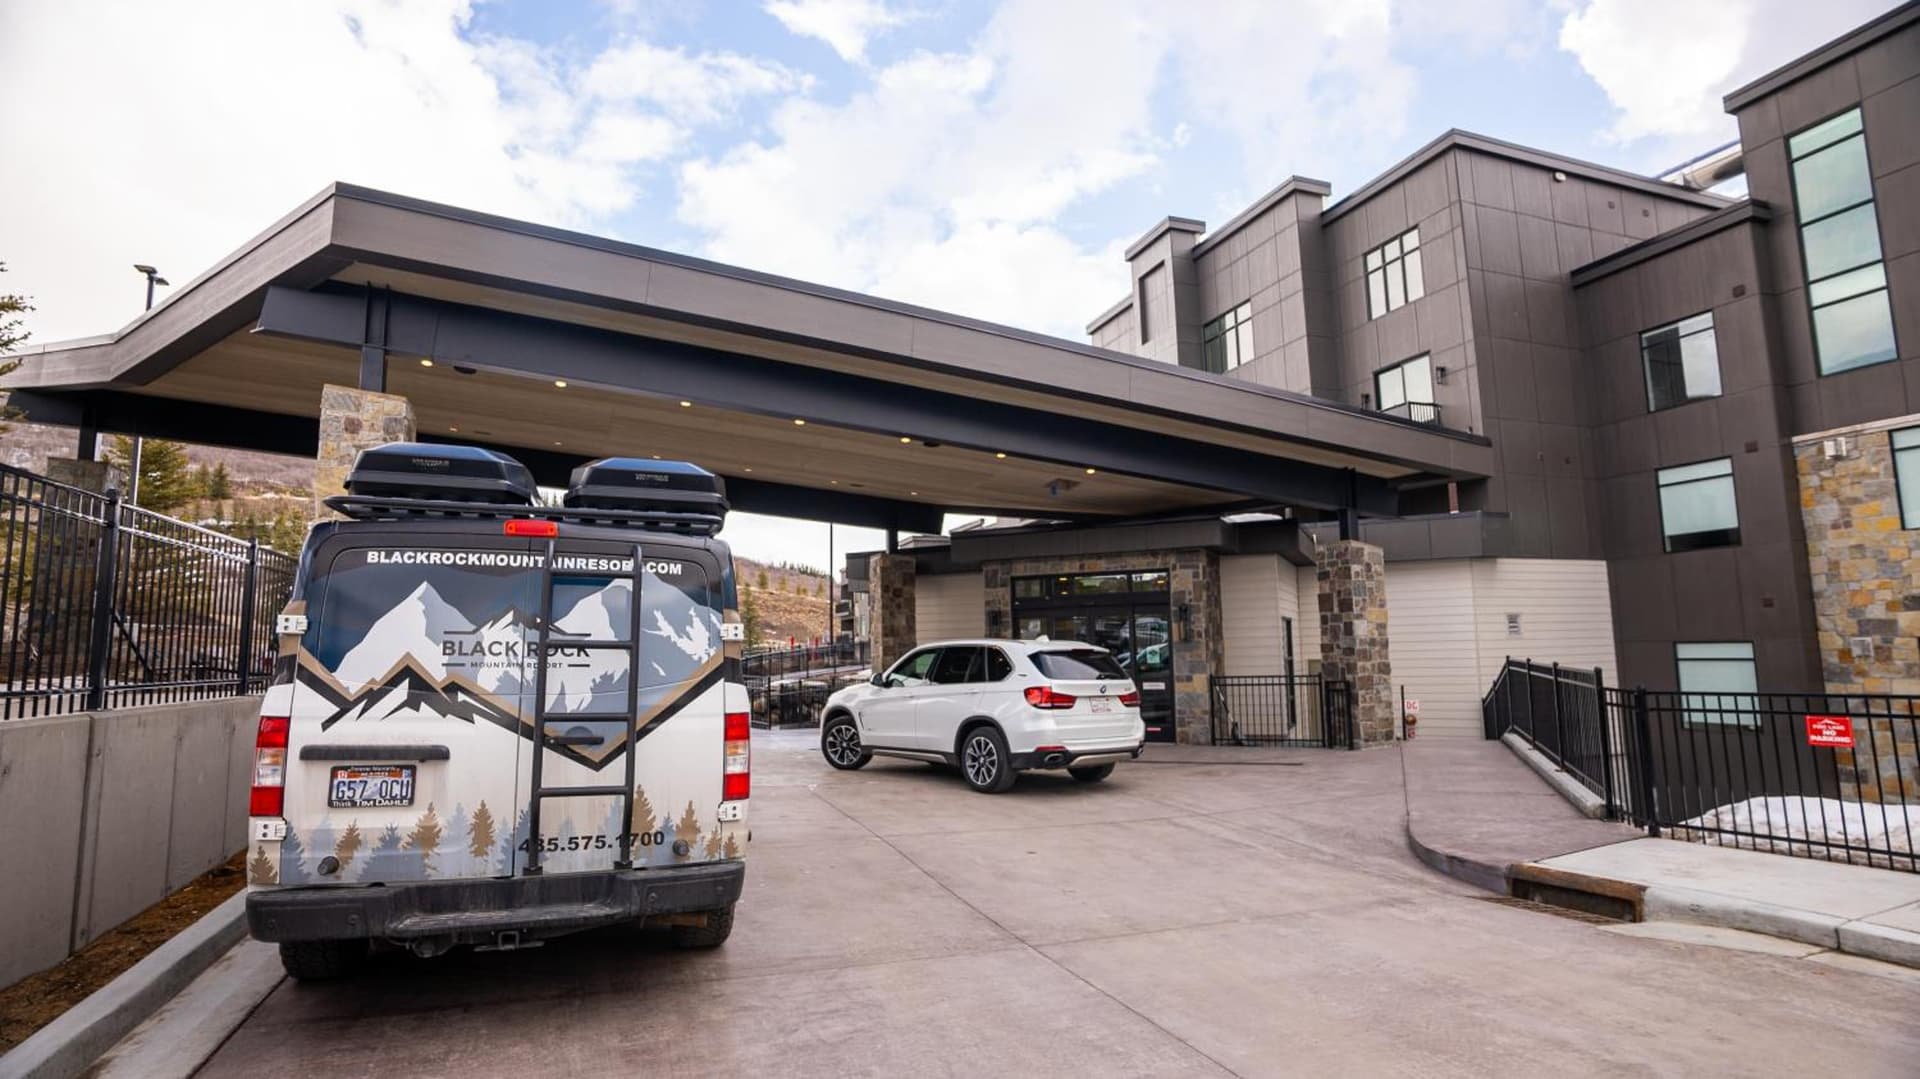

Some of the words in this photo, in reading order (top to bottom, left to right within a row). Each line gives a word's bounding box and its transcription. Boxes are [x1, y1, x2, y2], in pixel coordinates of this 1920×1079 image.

[366, 551, 682, 575] BLACKROCKMOUNTINRESOR.COM
[441, 640, 518, 656] BLACK
[470, 661, 523, 669] MOUNTAIN
[1809, 735, 1851, 743] PARKING
[336, 780, 368, 800] G57
[355, 800, 373, 808] TIM
[375, 798, 409, 807] DAHLE
